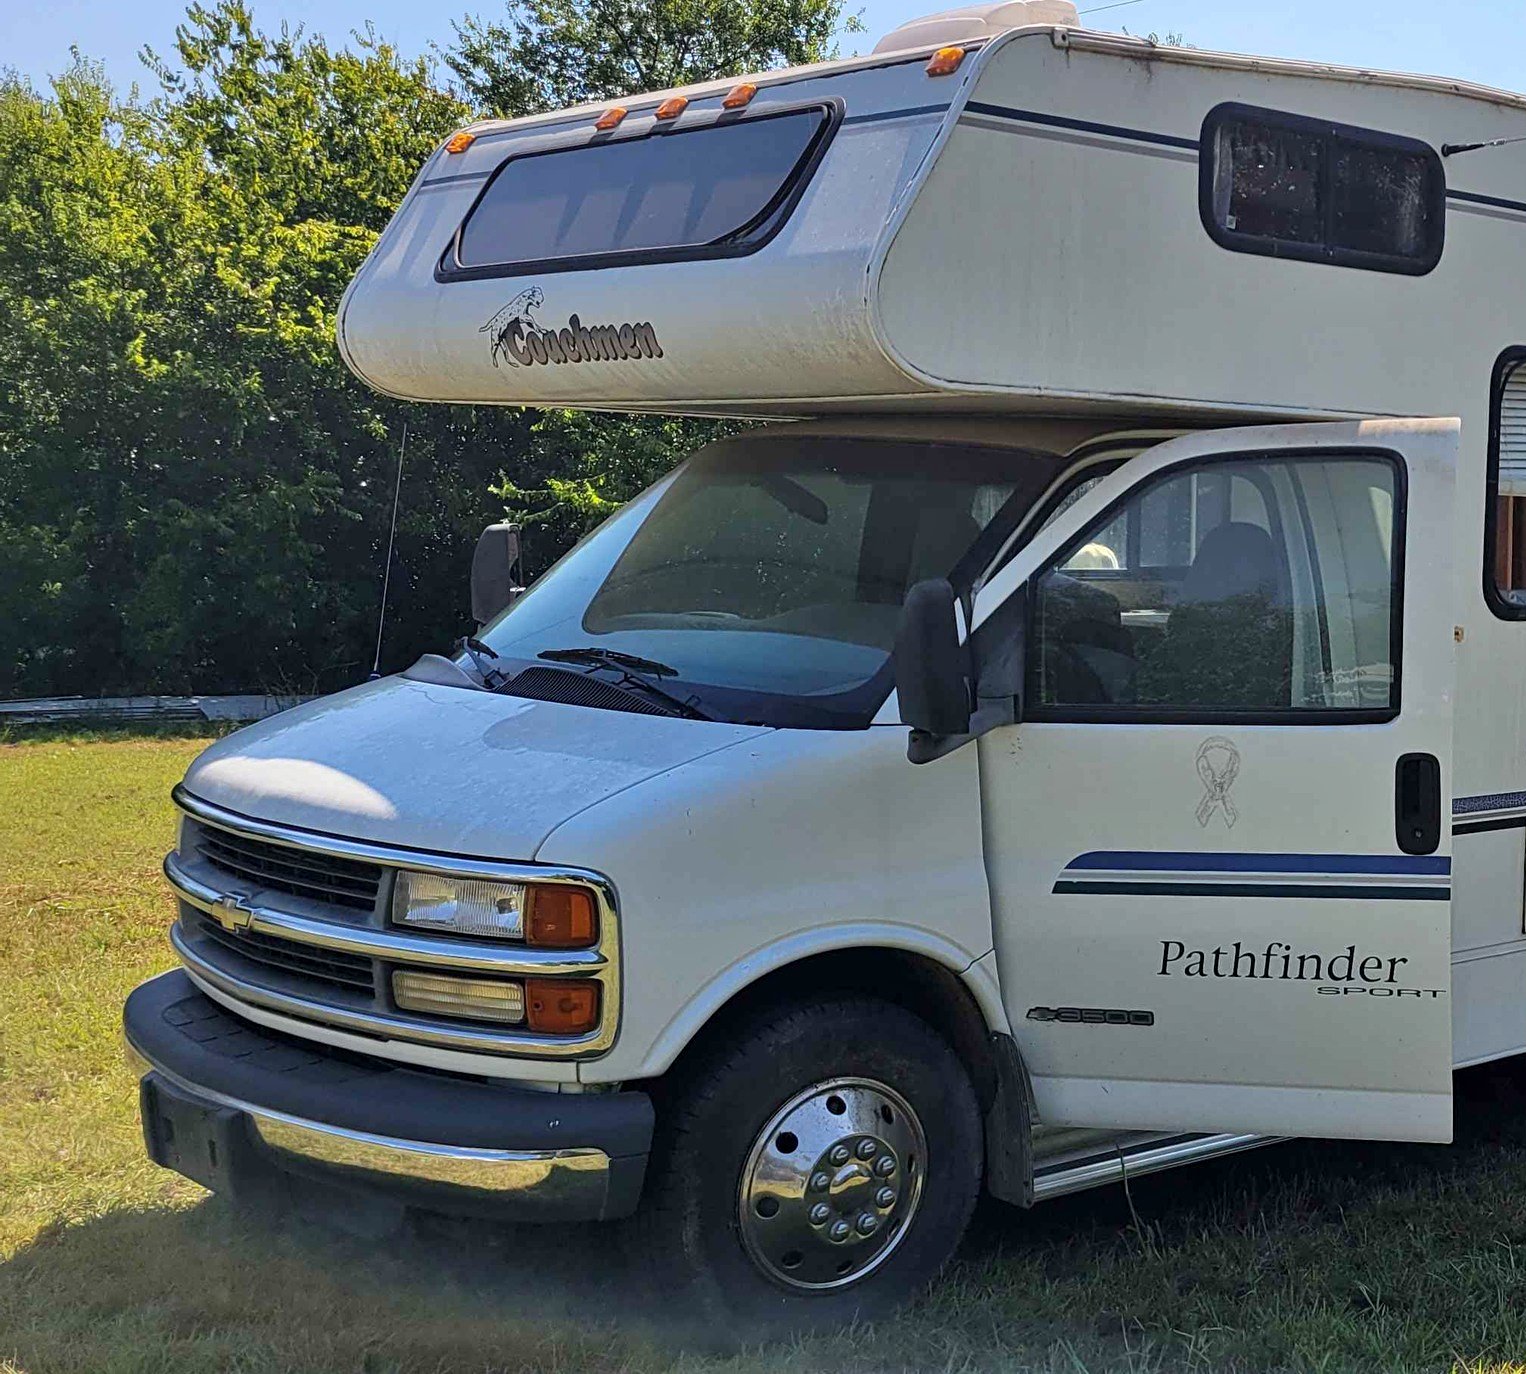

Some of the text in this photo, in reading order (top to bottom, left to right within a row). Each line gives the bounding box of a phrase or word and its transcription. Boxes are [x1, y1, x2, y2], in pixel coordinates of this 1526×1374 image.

[501, 314, 664, 366] Coachmen
[1156, 939, 1409, 984] Pathfinder
[1316, 986, 1447, 998] SPORT
[1057, 1007, 1154, 1026] 3500
